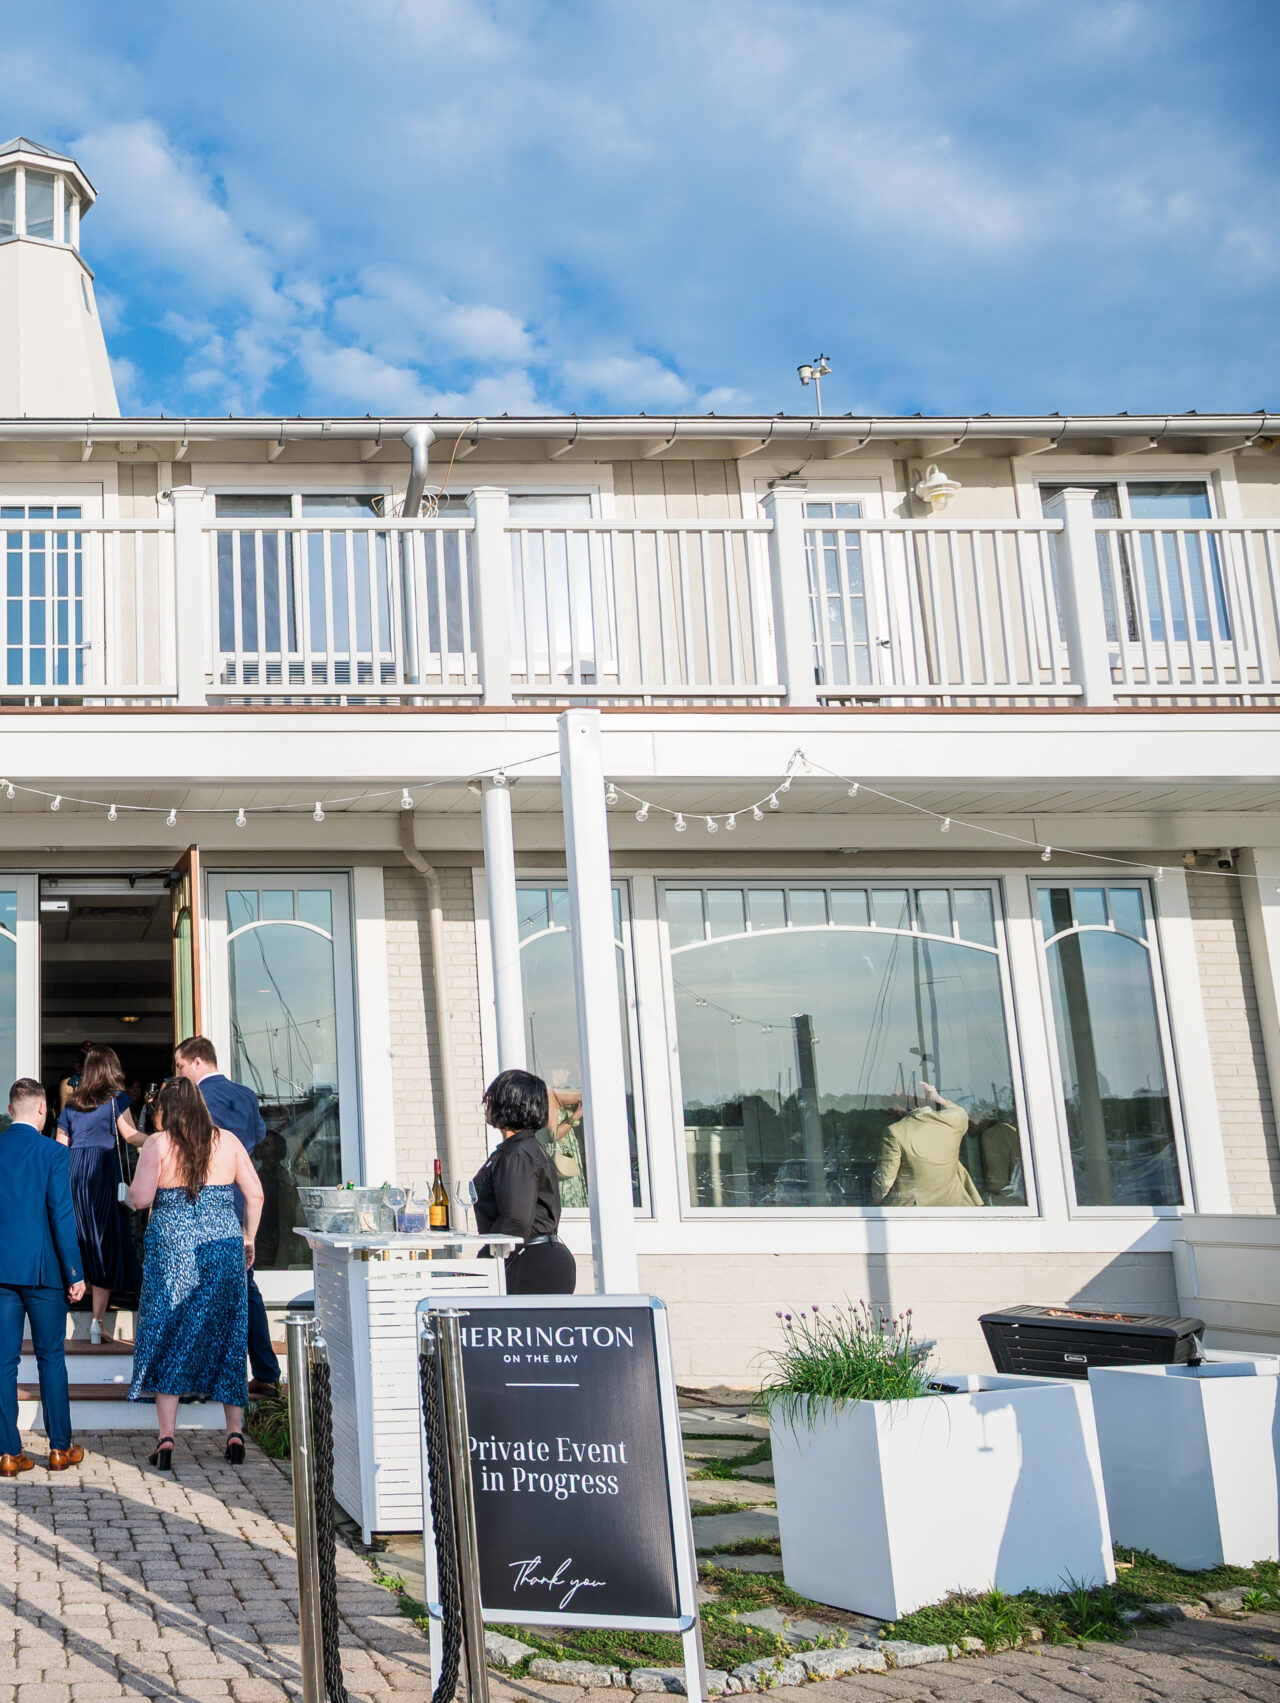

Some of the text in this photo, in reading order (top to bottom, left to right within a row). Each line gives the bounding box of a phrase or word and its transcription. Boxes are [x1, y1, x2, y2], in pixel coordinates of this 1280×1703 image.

[503, 1354, 579, 1364] ON THE BAY
[555, 1437, 628, 1465] Event
[481, 1465, 619, 1501] in Progress
[508, 1555, 607, 1610] Thank you
